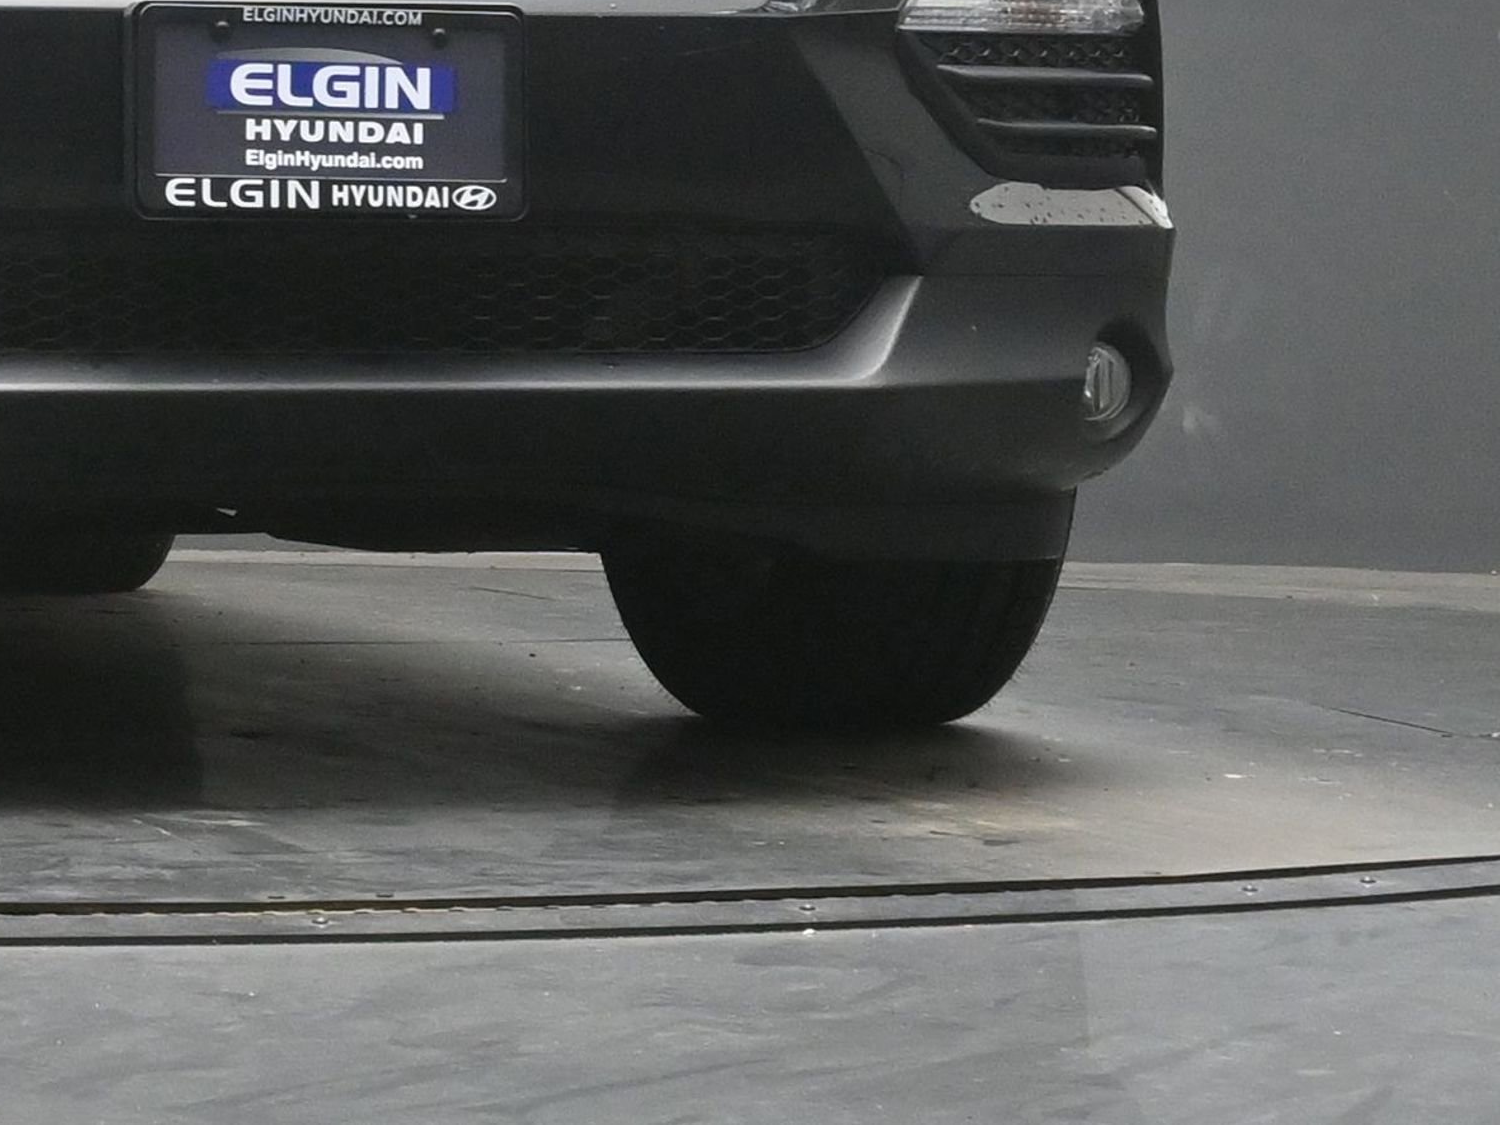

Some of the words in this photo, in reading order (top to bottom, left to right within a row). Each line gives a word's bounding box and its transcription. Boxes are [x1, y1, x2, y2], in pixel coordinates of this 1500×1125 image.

[242, 7, 423, 26] ELGINHYUNDAI.COM
[230, 62, 431, 110] ELGIN
[245, 118, 424, 145] HYUNDAI
[245, 149, 424, 171] ElginHyundai.com
[165, 177, 320, 210] ELGIN
[332, 184, 449, 209] HYUNDAI
